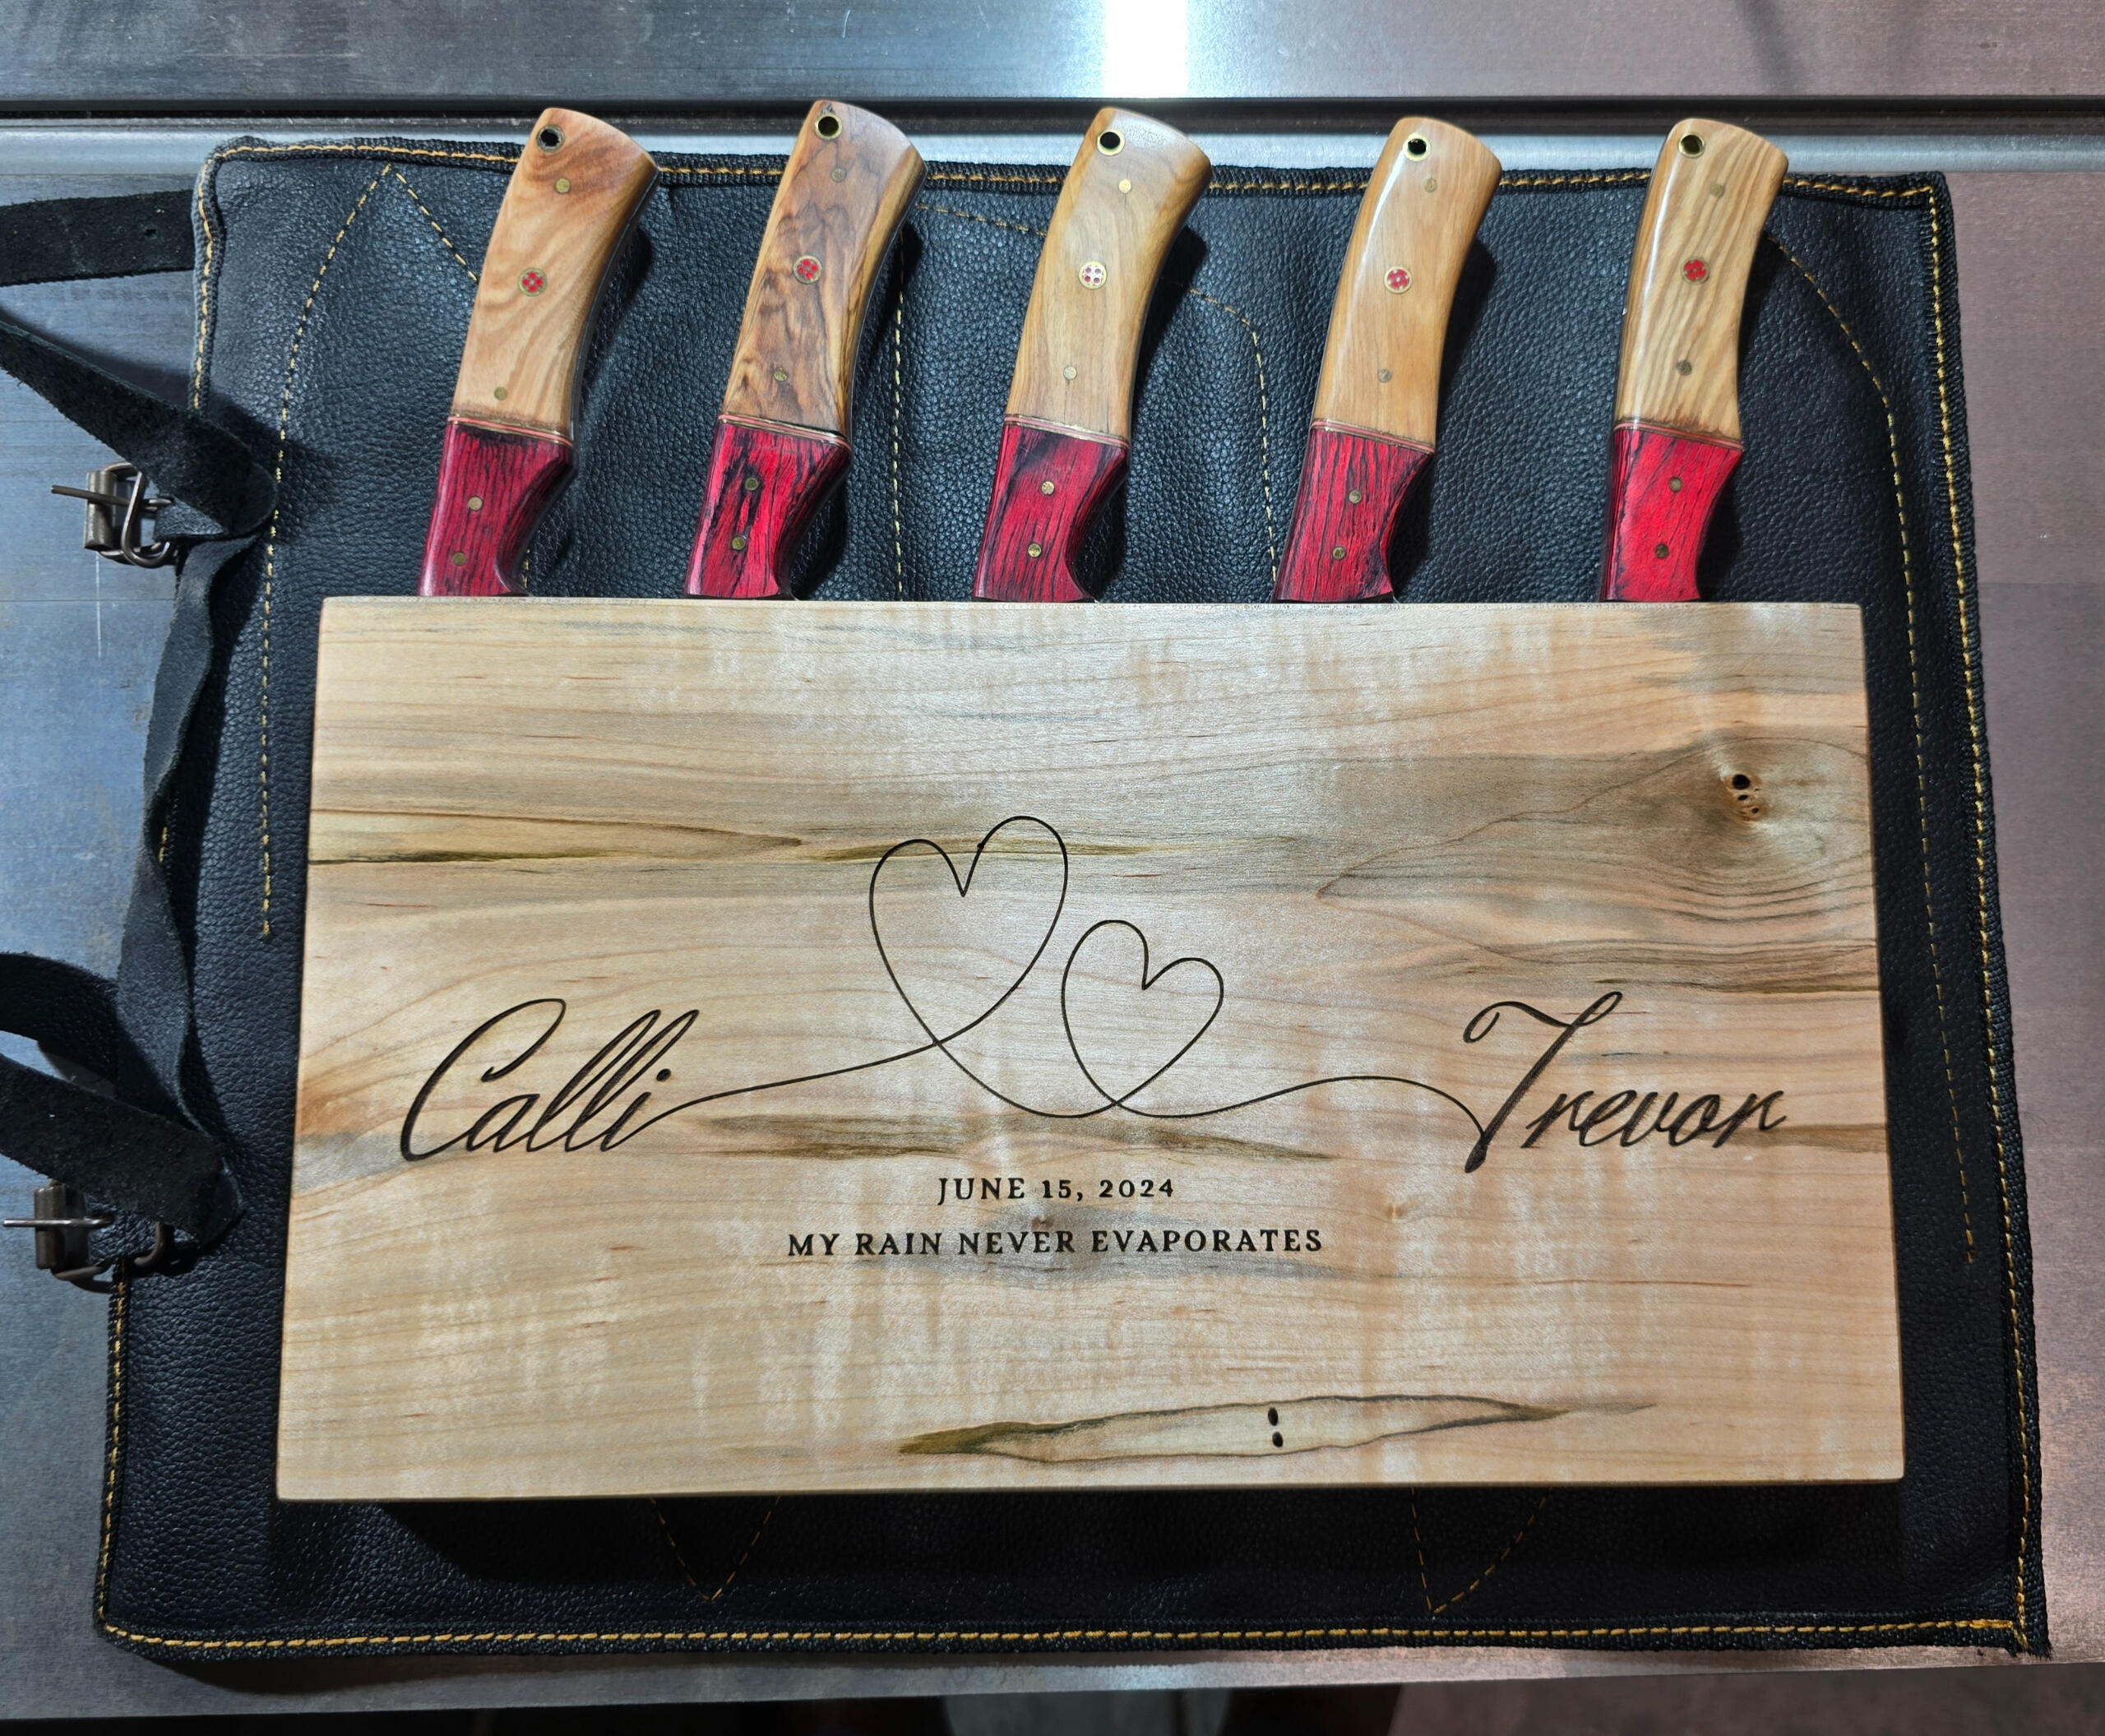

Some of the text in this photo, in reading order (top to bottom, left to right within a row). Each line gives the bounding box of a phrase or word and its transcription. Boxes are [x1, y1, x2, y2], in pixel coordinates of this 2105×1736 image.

[400, 998, 700, 1162] Calli
[1463, 991, 1788, 1174] Trevor
[936, 1177, 1174, 1206] JUNE 15, 2024
[787, 1229, 1322, 1257] MY RAIN NEVER EVAPORATES
